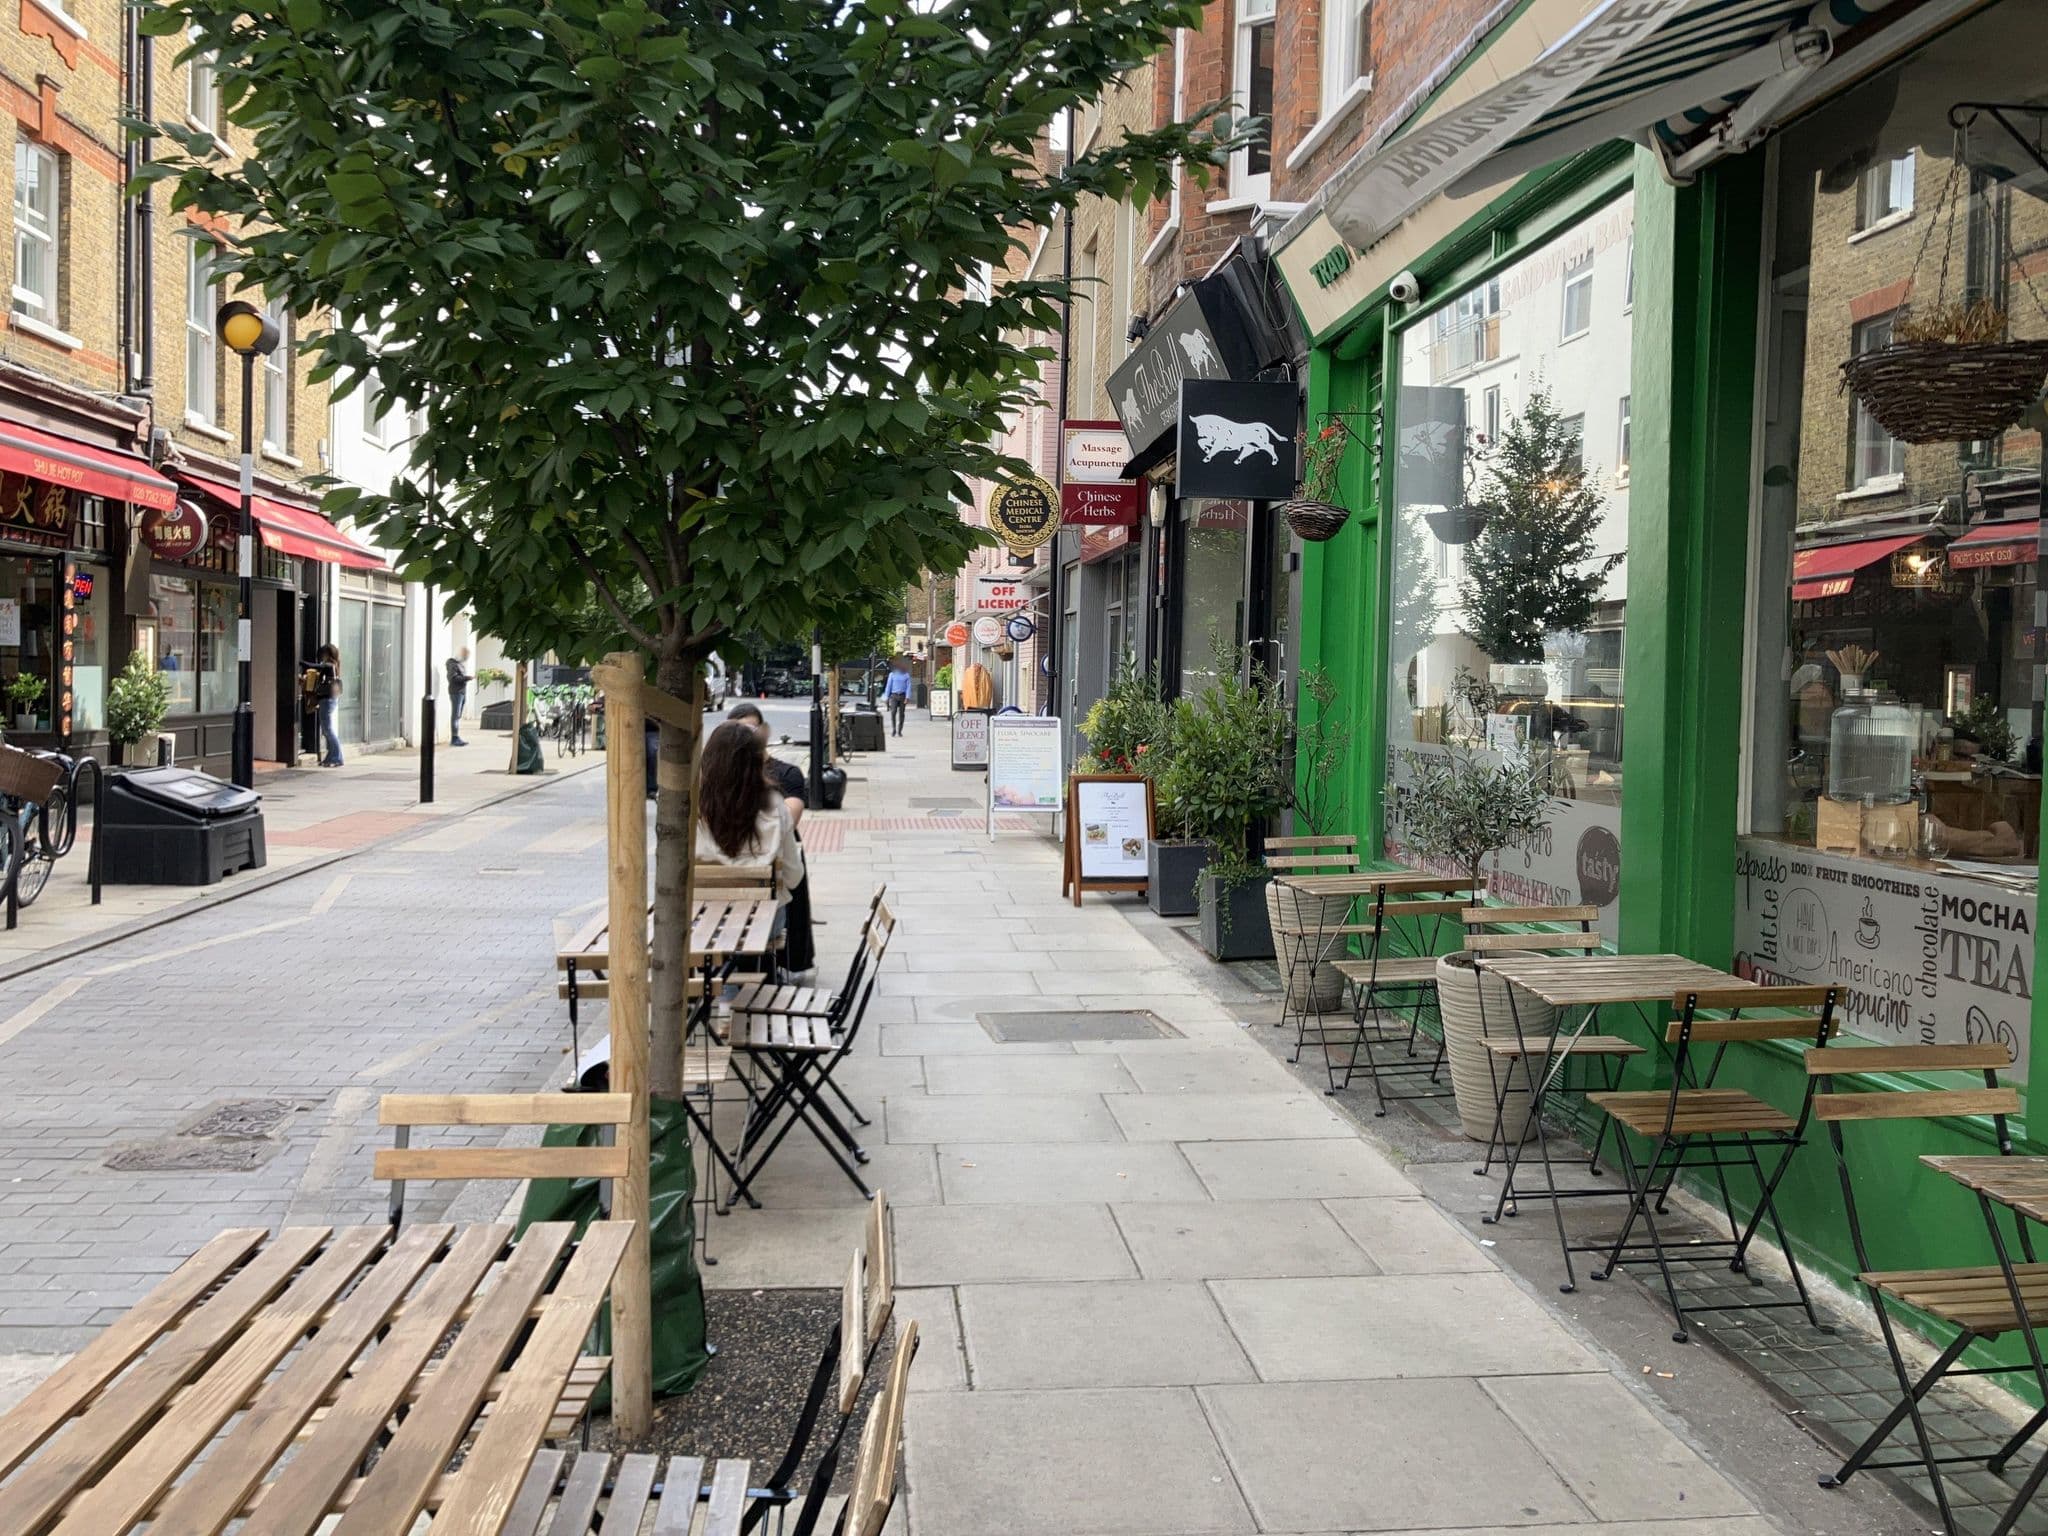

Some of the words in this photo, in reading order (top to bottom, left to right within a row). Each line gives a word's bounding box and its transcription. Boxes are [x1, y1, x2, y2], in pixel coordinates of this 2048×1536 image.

[1309, 243, 1354, 289] TRAD
[1502, 231, 1591, 308] SANDWICH
[1134, 363, 1162, 415] The
[1150, 332, 1183, 400] Bull
[1069, 457, 1128, 469] Acupunctur
[1082, 443, 1122, 455] Massage
[34, 458, 48, 475] SHU
[57, 465, 71, 481] HOT
[71, 469, 85, 485] POT
[1006, 499, 1044, 507] CHINESE
[1006, 507, 1044, 516] MEDICAL
[1077, 490, 1121, 502] Chinese
[1083, 505, 1116, 517] Herbs
[1008, 515, 1042, 524] CENTRE
[73, 578, 93, 594] PEN
[992, 586, 1016, 596] OFF
[978, 599, 1029, 609] LICENCE
[956, 730, 985, 740] LICENCE
[961, 719, 982, 730] OFF
[1502, 870, 1571, 906] BREAKFAST
[1582, 851, 1619, 894] tasty
[1736, 850, 1787, 911] espresso
[1791, 862, 1812, 877] 100%
[1816, 866, 1848, 884] FRUIT
[1851, 873, 1920, 898] SMOOTHIES
[1754, 888, 1779, 963] latte
[1941, 894, 2030, 935] MOCHA
[1914, 886, 1939, 999] chocolate
[1829, 930, 1913, 997] Americano
[1940, 927, 2033, 1001] TEA
[1844, 987, 1912, 1034] ppucino
